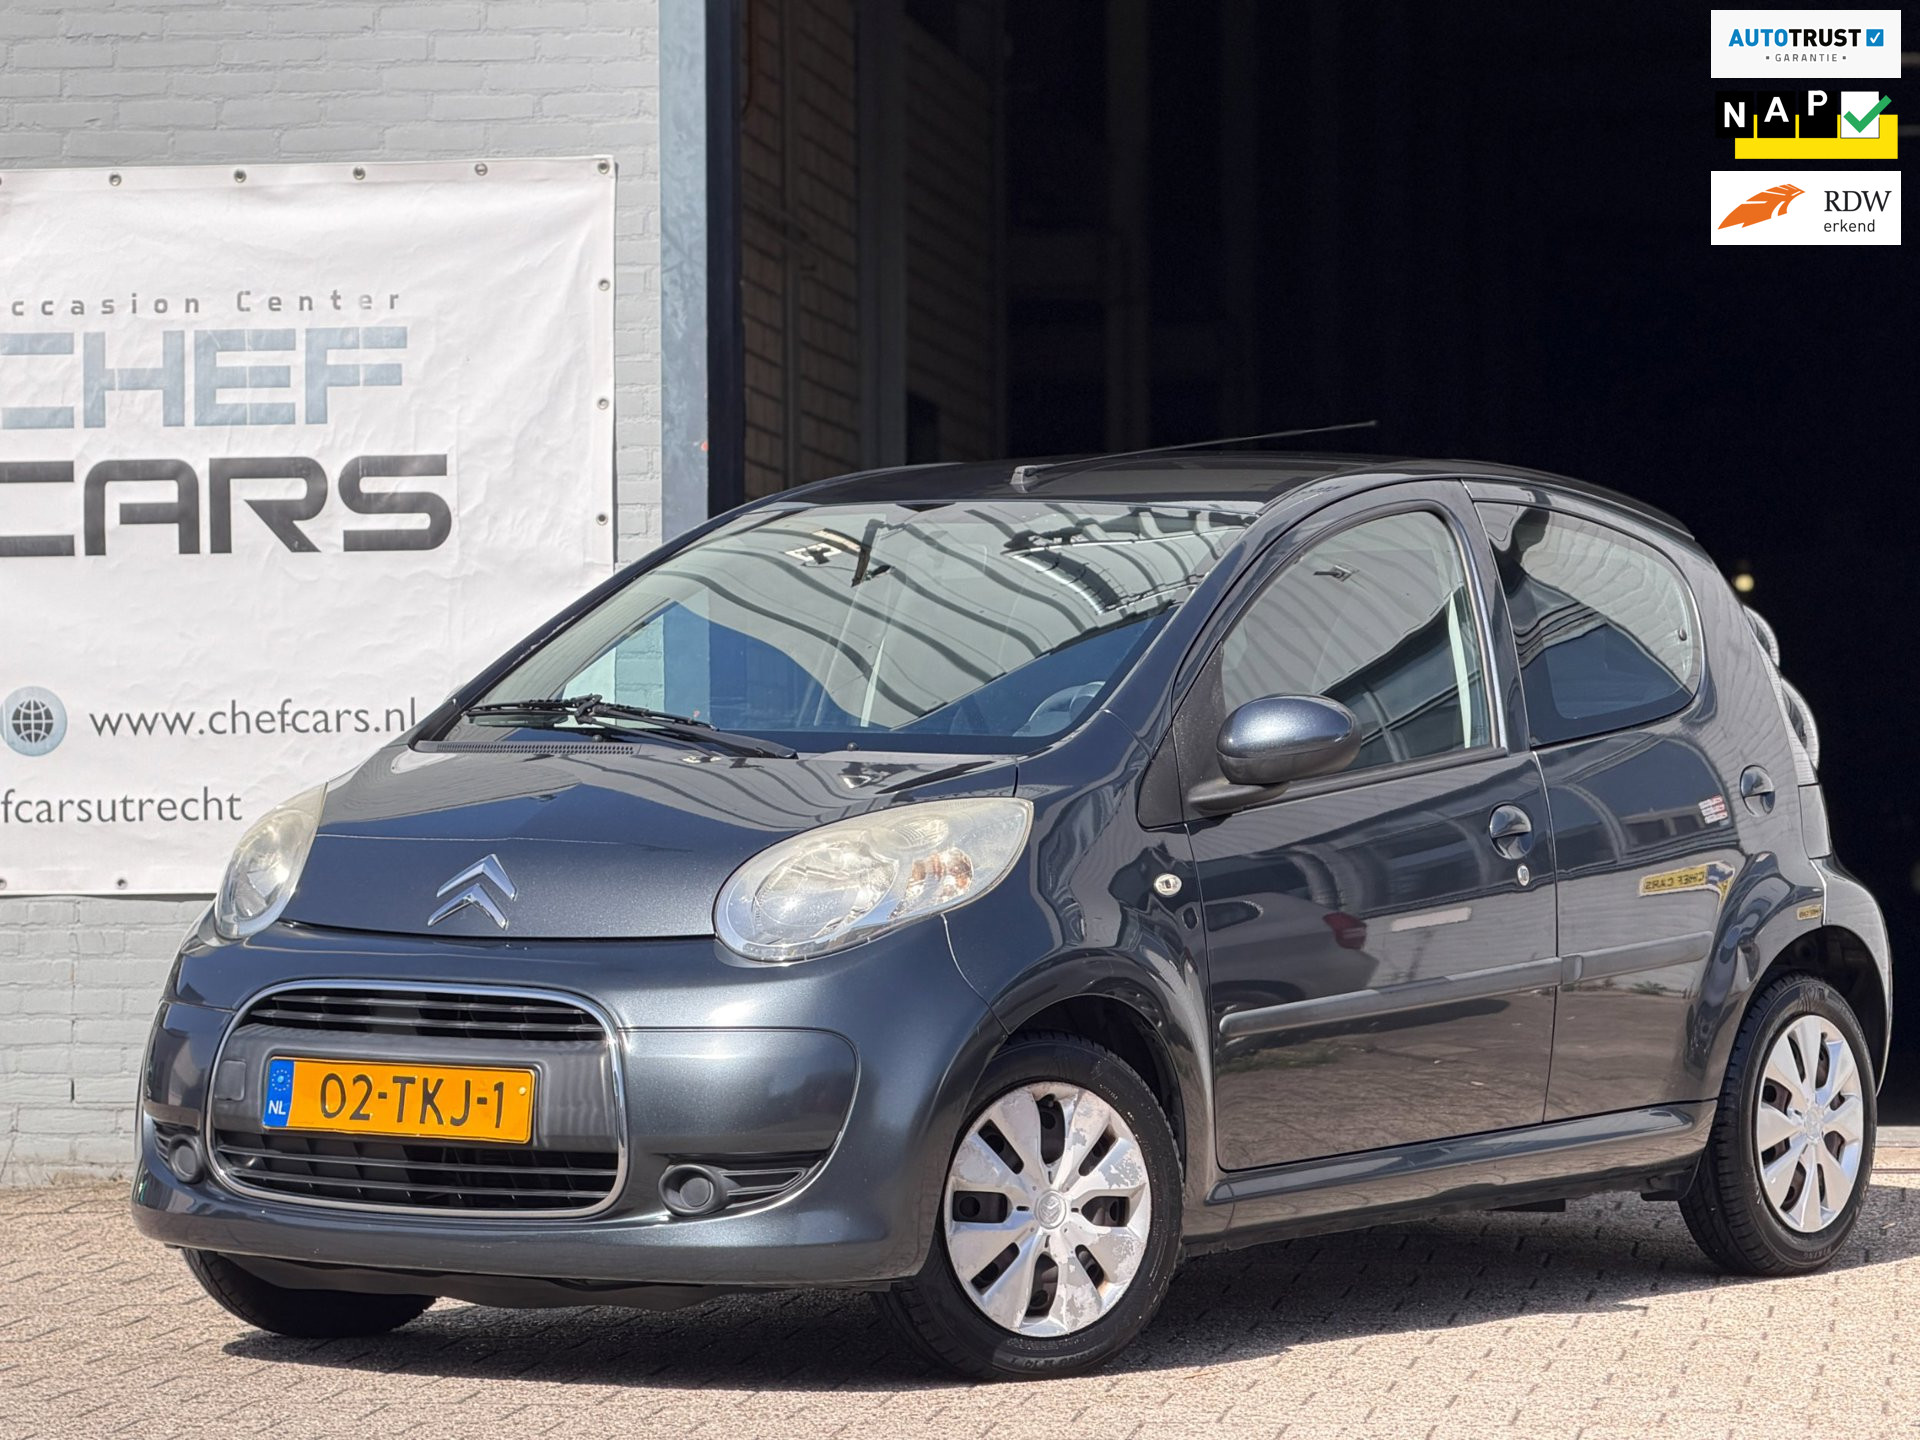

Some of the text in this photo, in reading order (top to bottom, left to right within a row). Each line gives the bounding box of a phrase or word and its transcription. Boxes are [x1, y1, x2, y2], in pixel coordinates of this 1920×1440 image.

[237, 289, 400, 312] Center
[0, 326, 408, 430] CHEF
[0, 453, 452, 557] CARS
[89, 697, 416, 736] www.chefcars.nl
[0, 786, 243, 824] fcarsutrecht
[268, 1100, 286, 1116] NL
[320, 1072, 504, 1129] 02-TKJ-1
